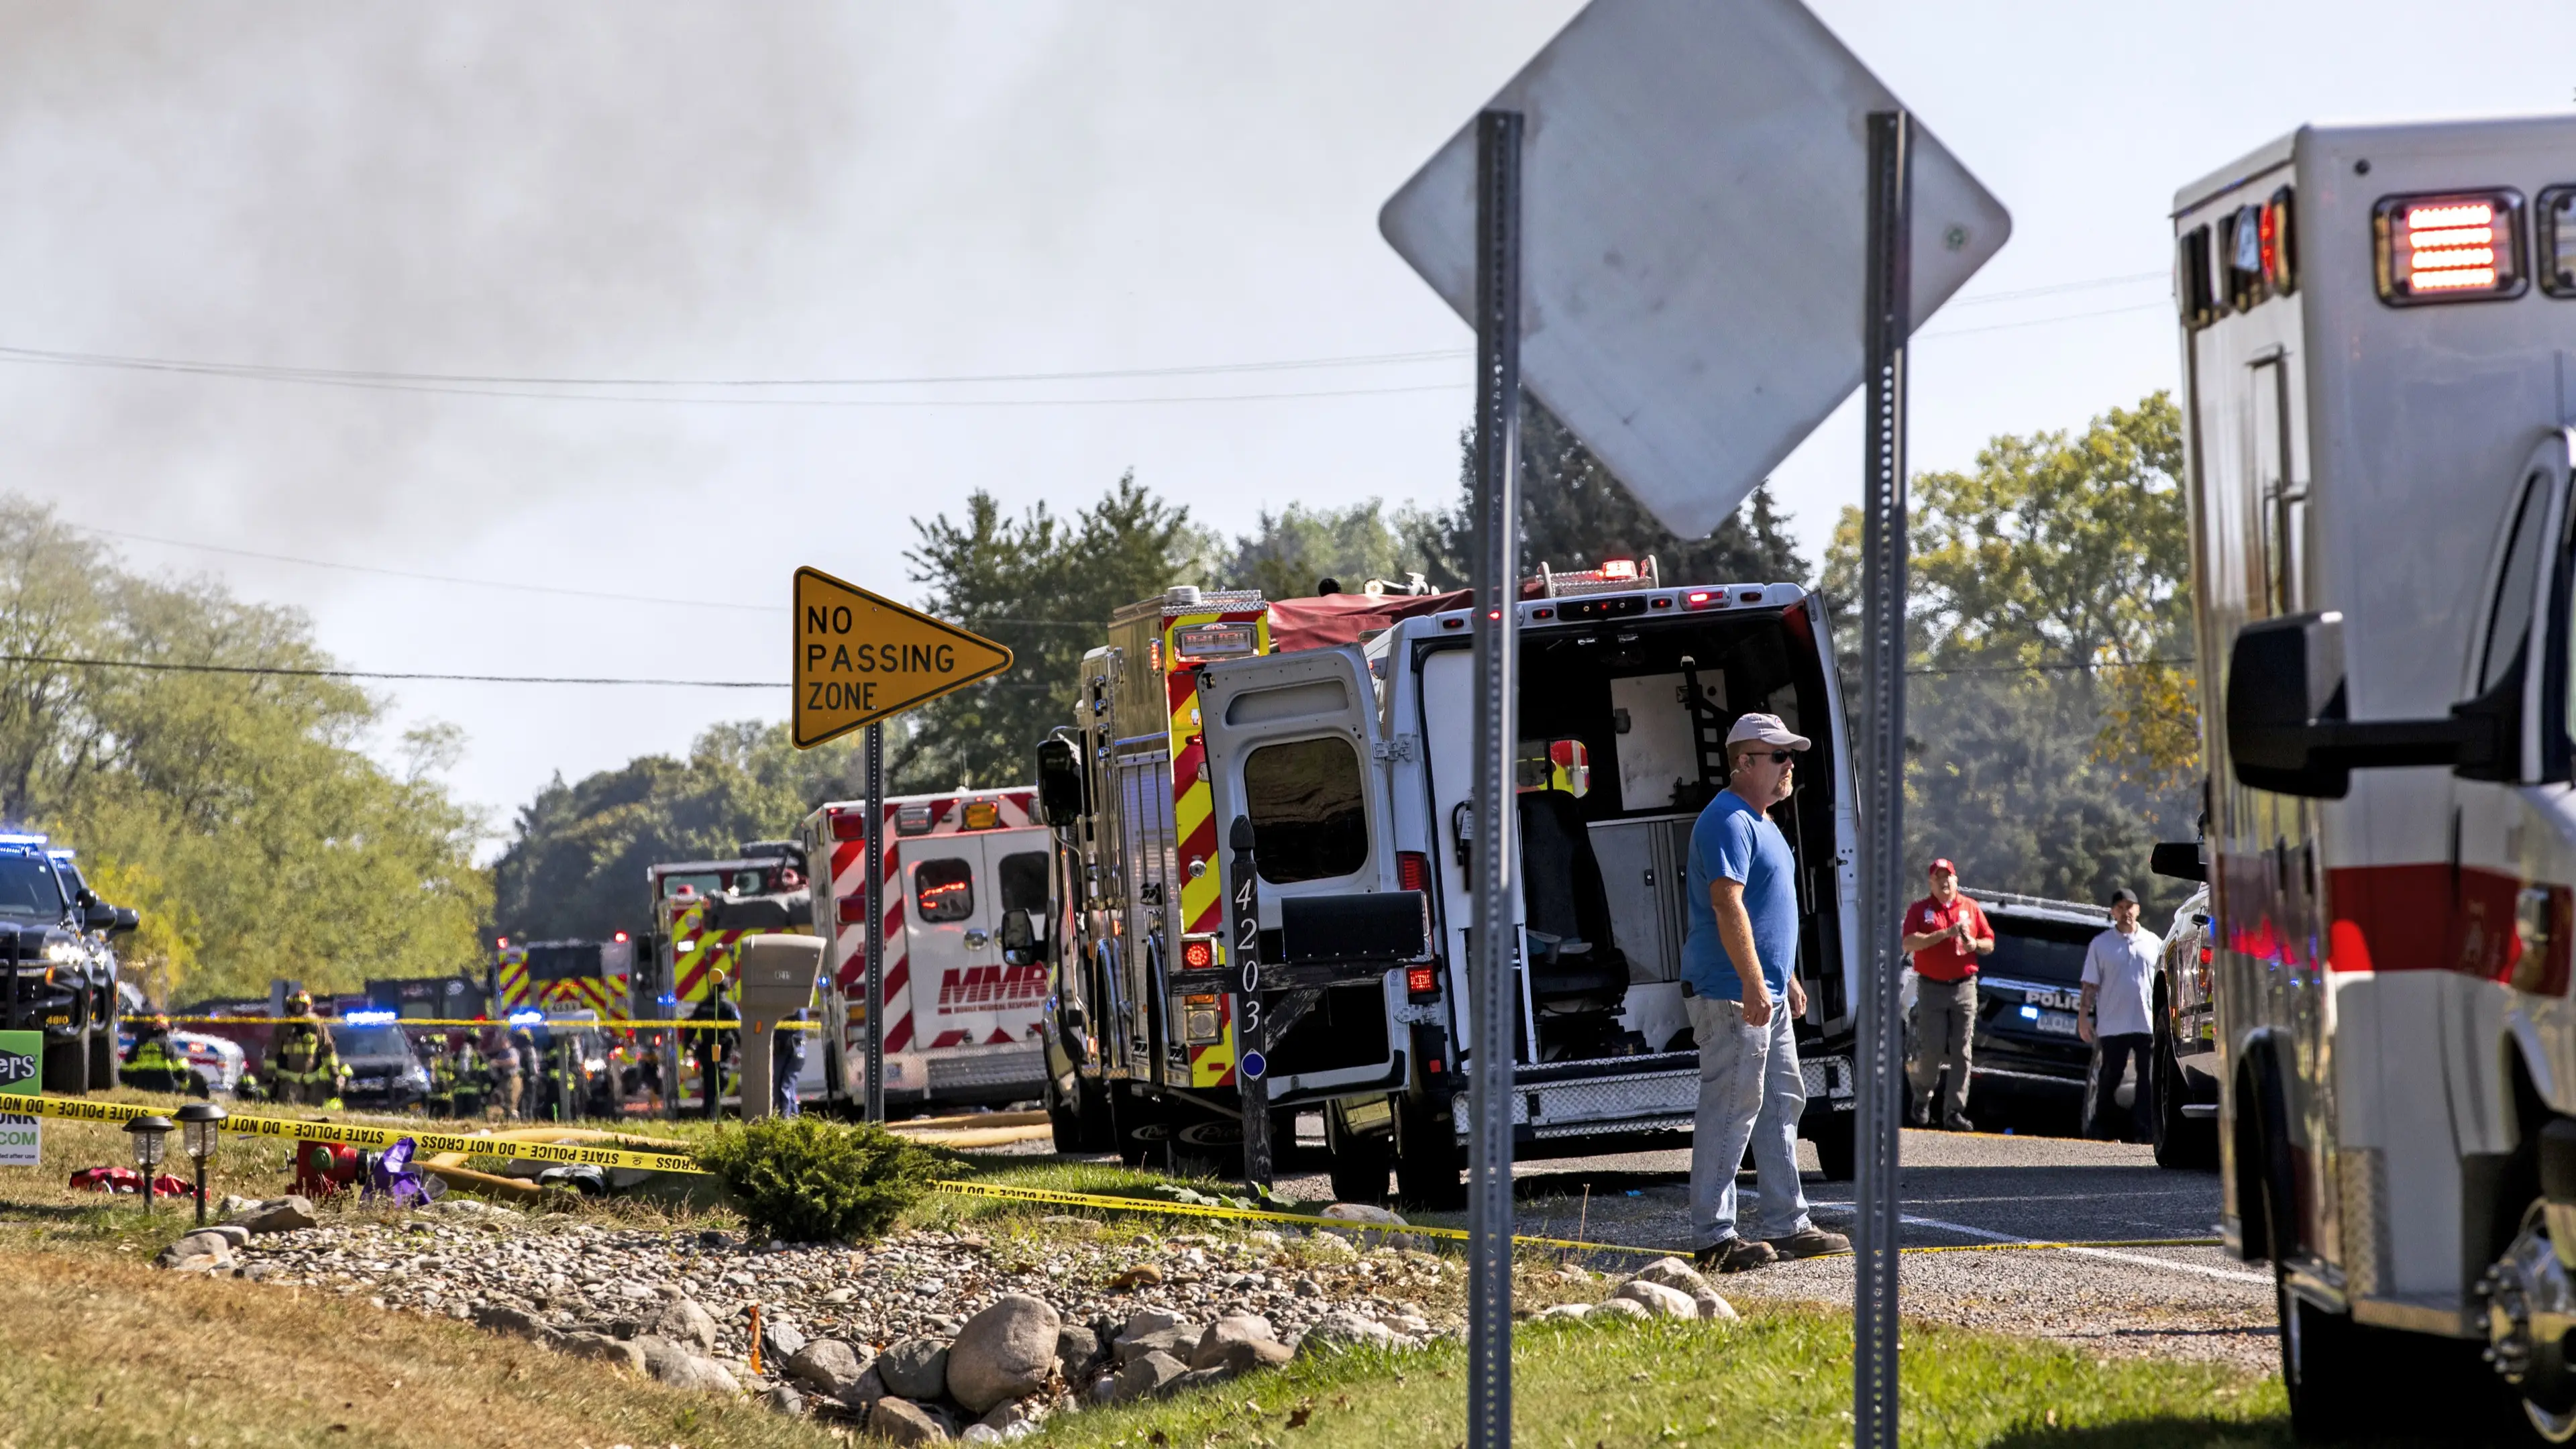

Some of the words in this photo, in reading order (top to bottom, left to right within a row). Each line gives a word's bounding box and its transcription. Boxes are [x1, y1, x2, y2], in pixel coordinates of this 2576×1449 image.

[807, 605, 853, 635] NO
[807, 643, 955, 673] PASSING
[807, 682, 877, 710] ZONE
[1235, 879, 1260, 1033] 4203
[938, 960, 1047, 1004] MMR
[2026, 990, 2094, 1012] POLIC
[25, 1099, 44, 1113] DO
[58, 1102, 105, 1120] POLICE
[232, 1118, 258, 1132] NOT
[262, 1120, 280, 1134] DO
[294, 1124, 341, 1140] POLICE
[345, 1128, 384, 1144] STATE
[421, 1135, 464, 1150] CROSS
[468, 1140, 494, 1153] NOT
[498, 1142, 516, 1156] DO
[530, 1145, 576, 1161] POLICE
[581, 1150, 619, 1164] STATE
[656, 1157, 698, 1171] CROSS
